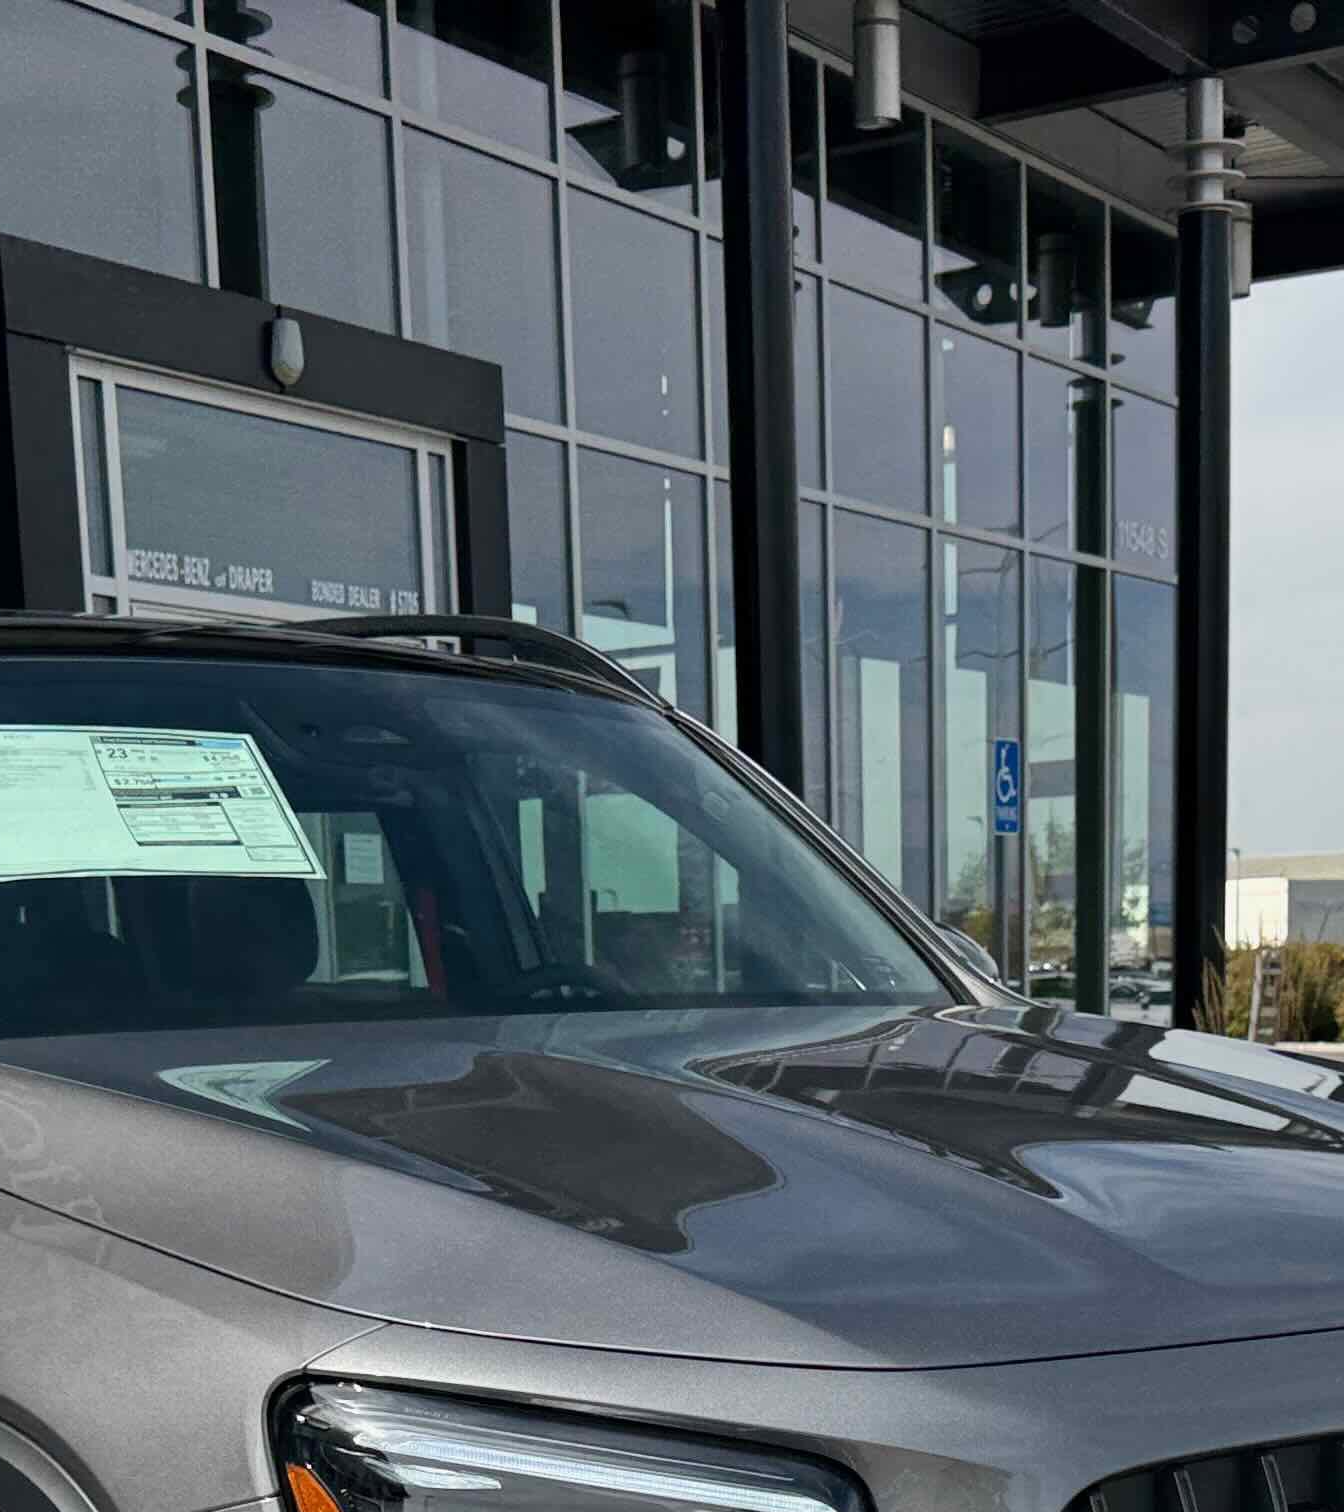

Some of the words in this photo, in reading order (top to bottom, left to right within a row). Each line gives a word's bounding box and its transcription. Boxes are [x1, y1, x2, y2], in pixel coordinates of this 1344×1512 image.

[228, 564, 273, 593] DRAPER
[348, 585, 380, 609] DEALER
[106, 747, 128, 760] 23
